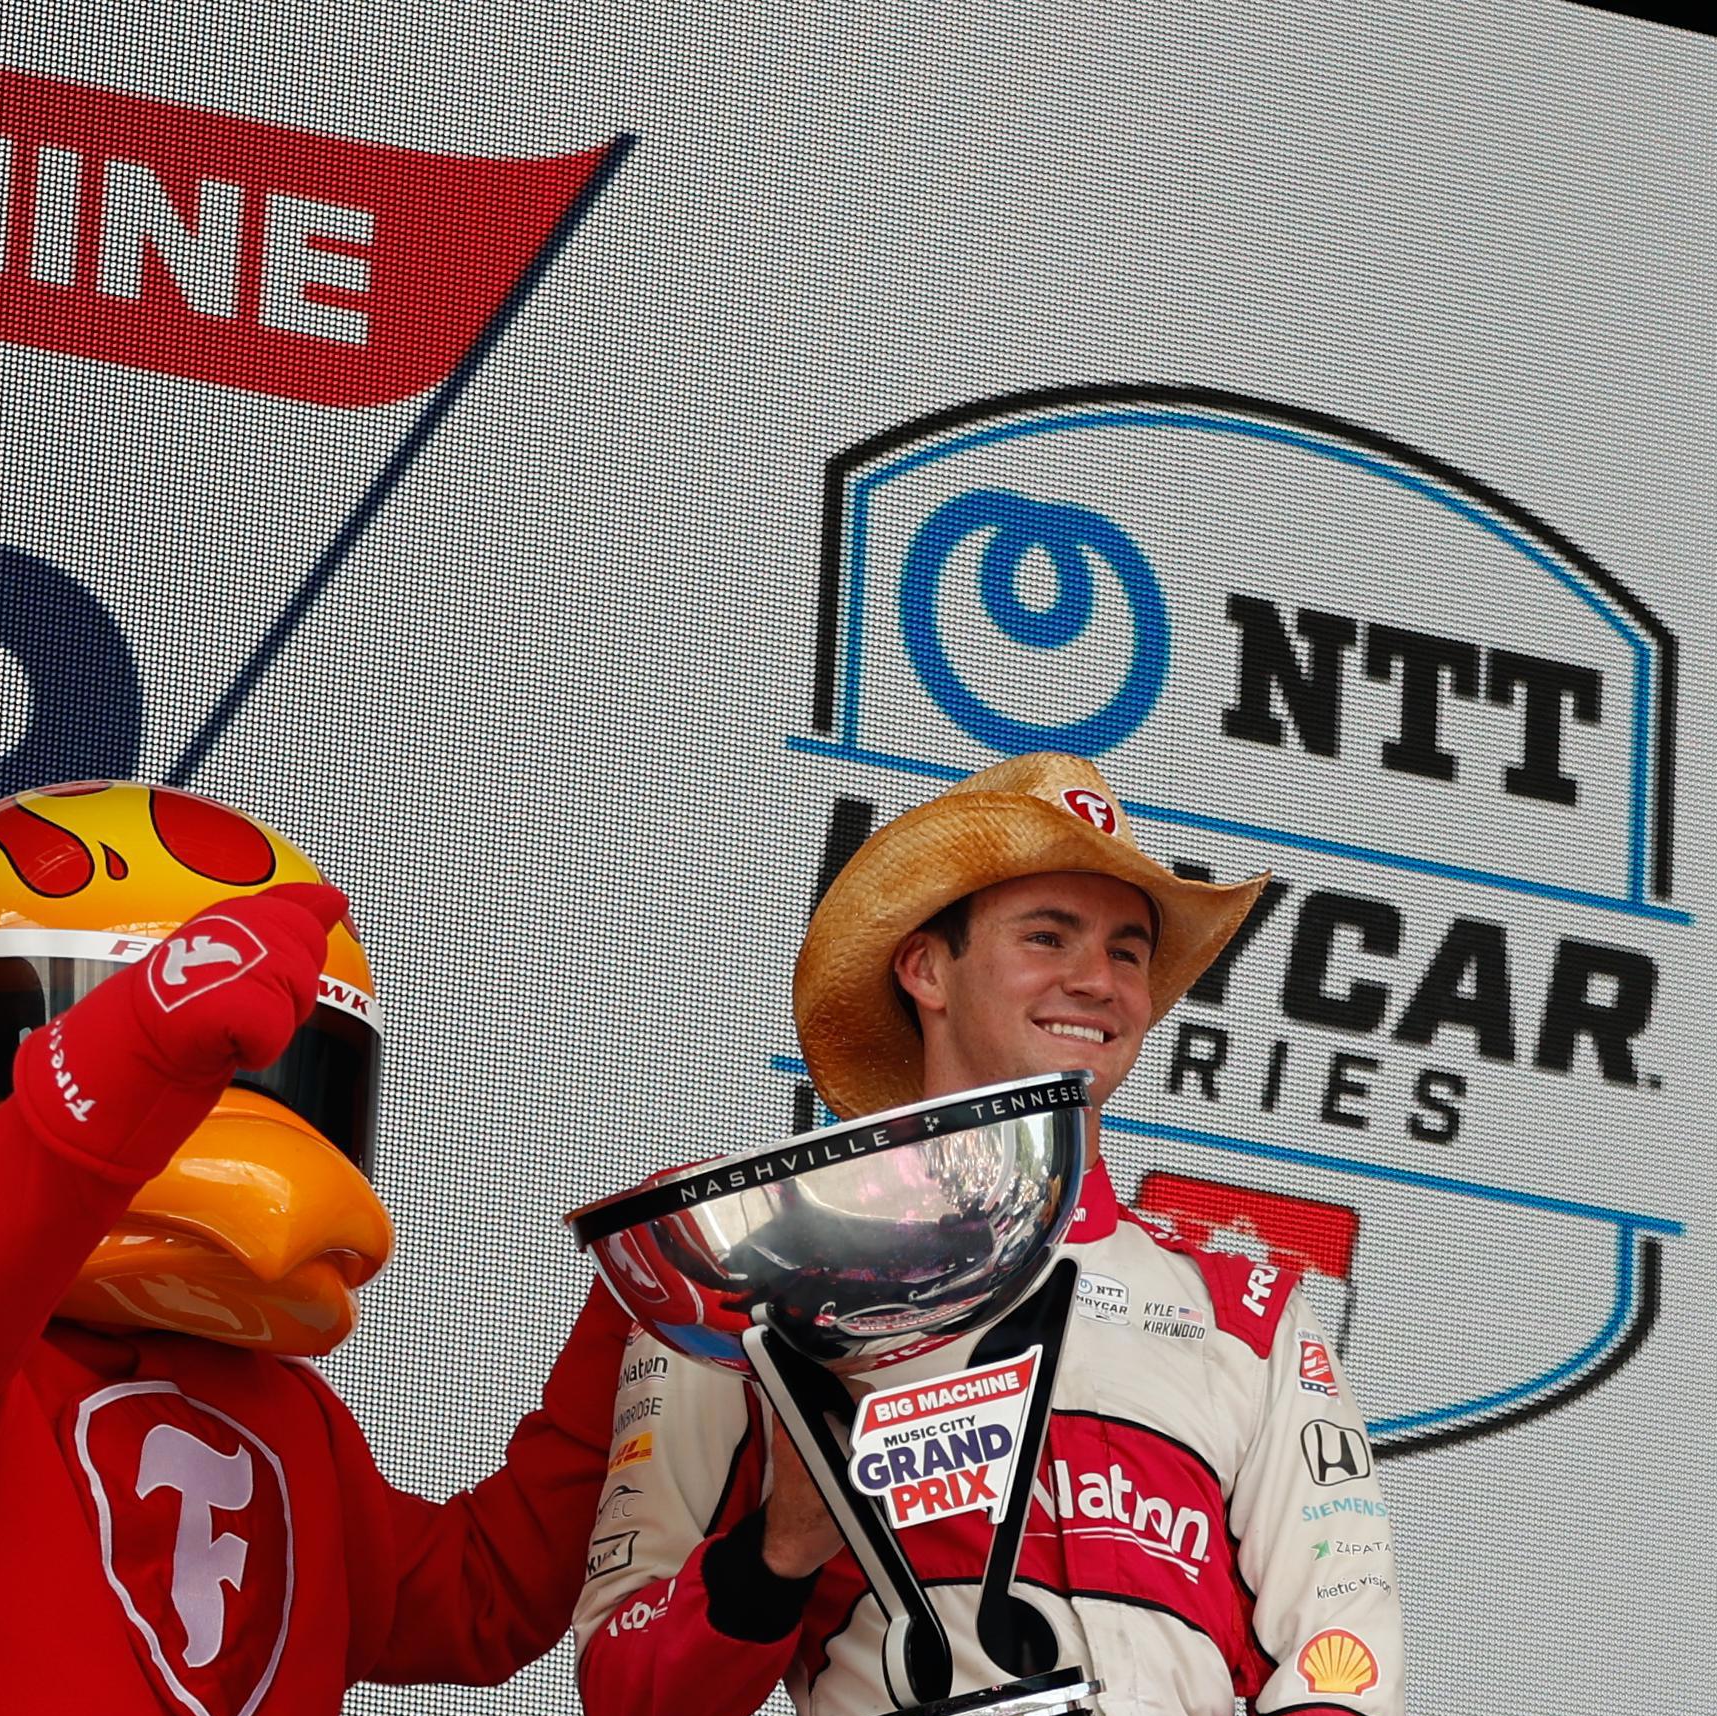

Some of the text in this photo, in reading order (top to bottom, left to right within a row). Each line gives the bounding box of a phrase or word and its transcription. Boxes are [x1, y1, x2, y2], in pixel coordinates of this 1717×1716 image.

[1221, 594, 1603, 807] NTT
[1168, 1022, 1468, 1145] RIES
[680, 1129, 891, 1204] NASHVILLE
[1075, 1294, 1128, 1315] NDYCAR
[1095, 1284, 1125, 1298] NTT
[1143, 1301, 1175, 1318] KYLE
[1143, 1319, 1206, 1340] KIRKWOOD
[874, 1370, 1020, 1423] BIG MACHINE
[884, 1414, 977, 1449] MUSIC CITY
[857, 1423, 1013, 1490] GRAND
[890, 1464, 999, 1522] PRIX
[1301, 1496, 1388, 1522] SIEMENS
[1335, 1540, 1392, 1555] ZAPATA
